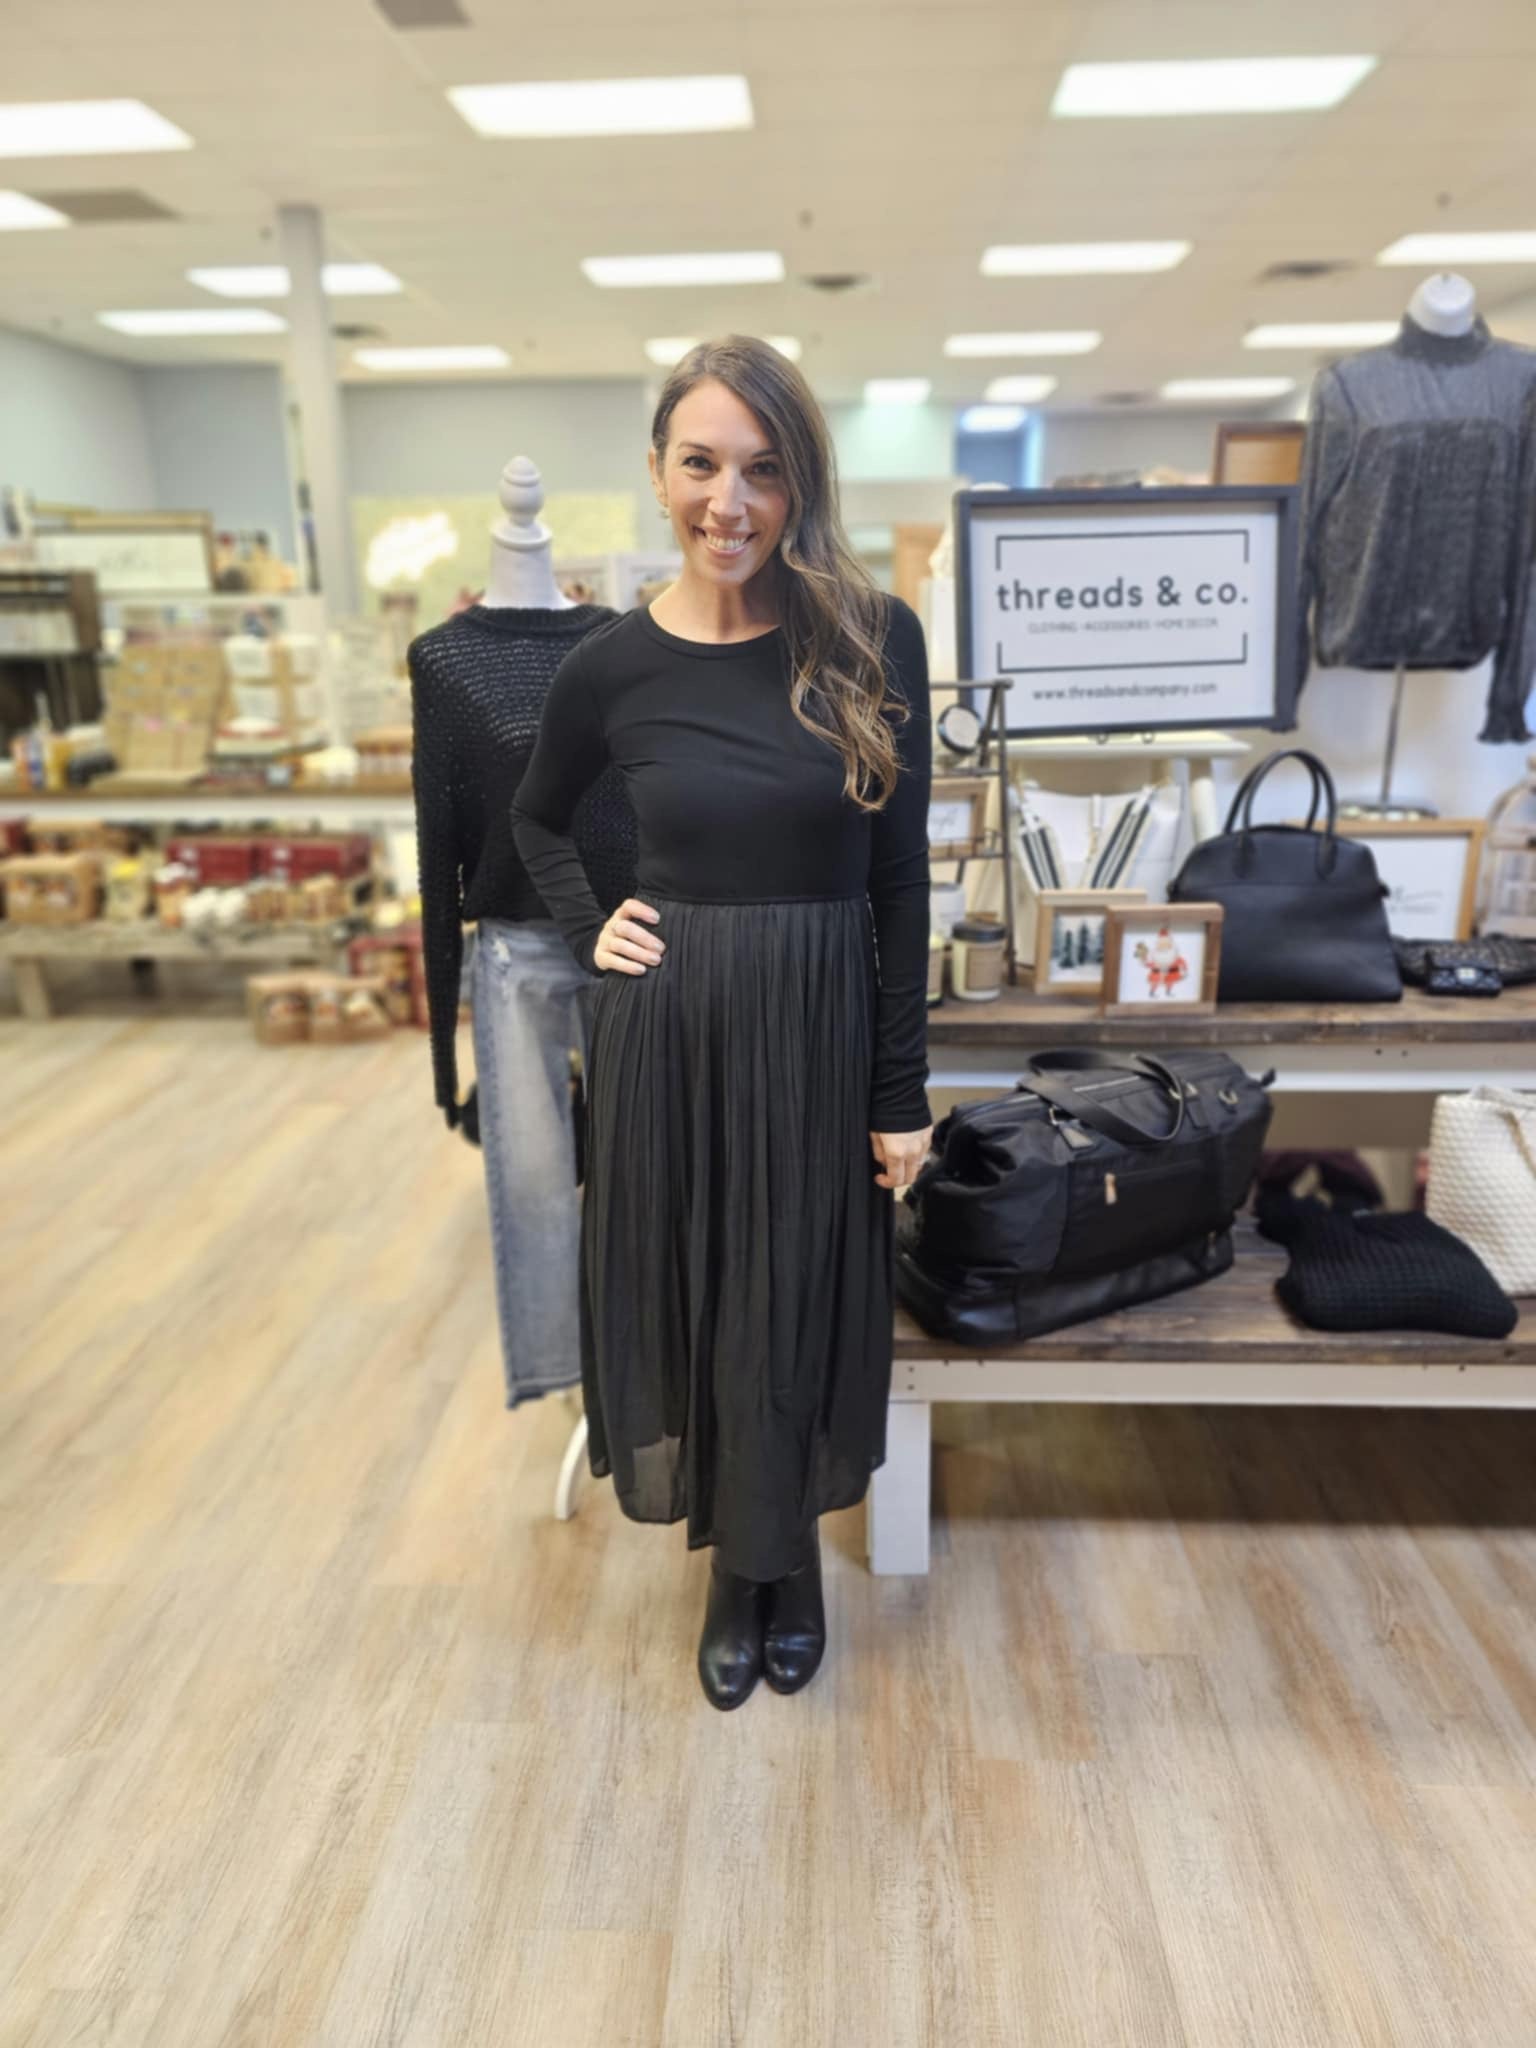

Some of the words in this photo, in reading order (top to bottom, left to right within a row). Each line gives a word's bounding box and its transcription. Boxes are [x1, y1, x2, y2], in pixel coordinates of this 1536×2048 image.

[997, 575, 1144, 612] threads
[1156, 575, 1182, 607] &
[1194, 582, 1249, 605] co.
